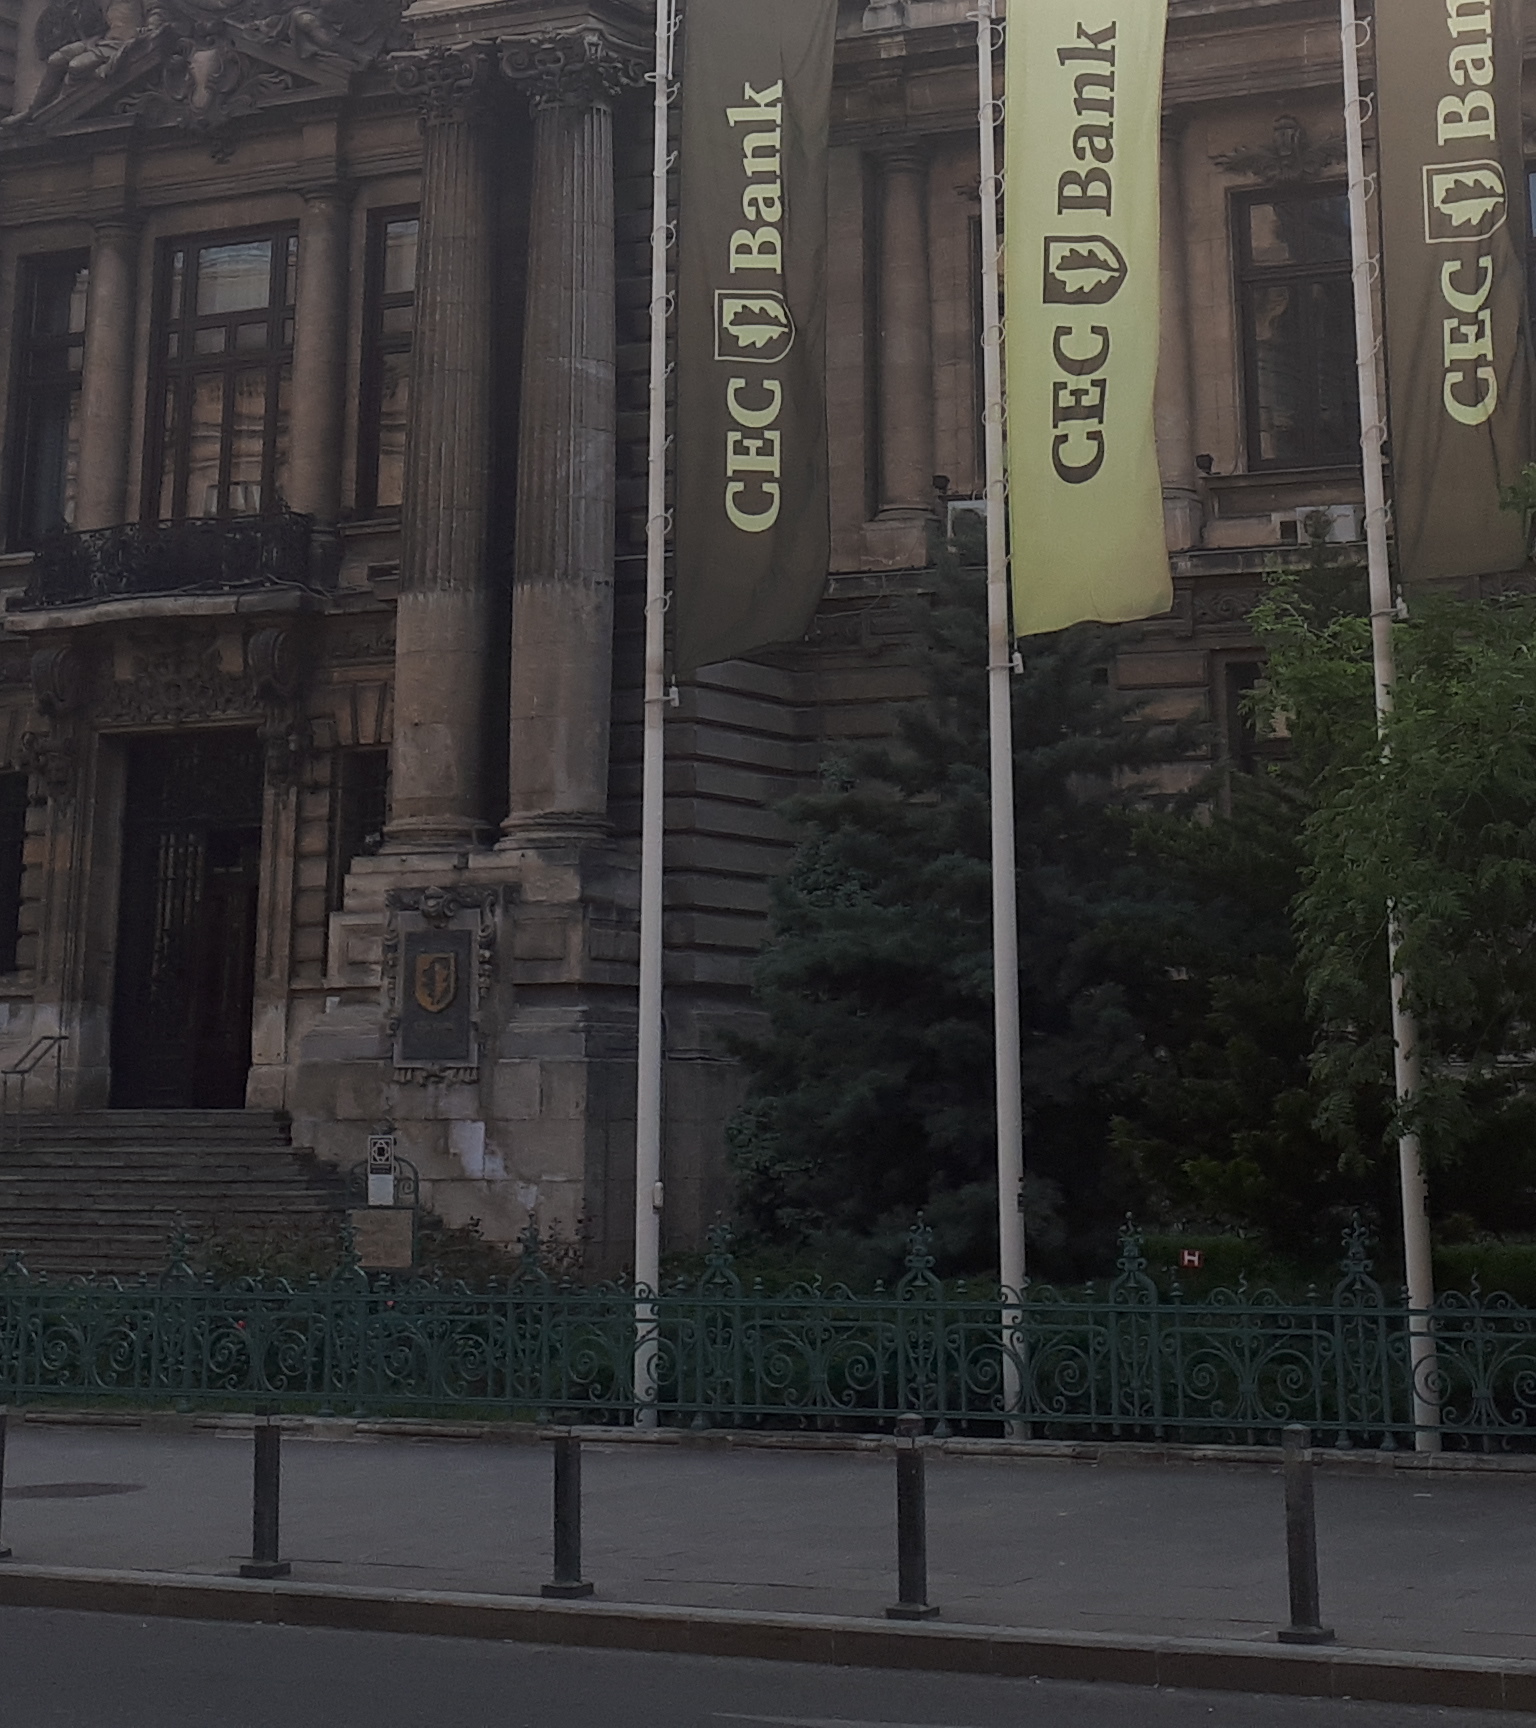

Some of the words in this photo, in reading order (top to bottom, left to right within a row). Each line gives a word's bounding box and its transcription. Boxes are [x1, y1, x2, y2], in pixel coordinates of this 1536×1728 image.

[726, 79, 783, 275] Bank
[1056, 20, 1117, 218] Bank
[1052, 325, 1110, 485] CEC
[1441, 256, 1498, 426] CEC
[725, 377, 782, 532] CEC
[1183, 1249, 1199, 1267] H
